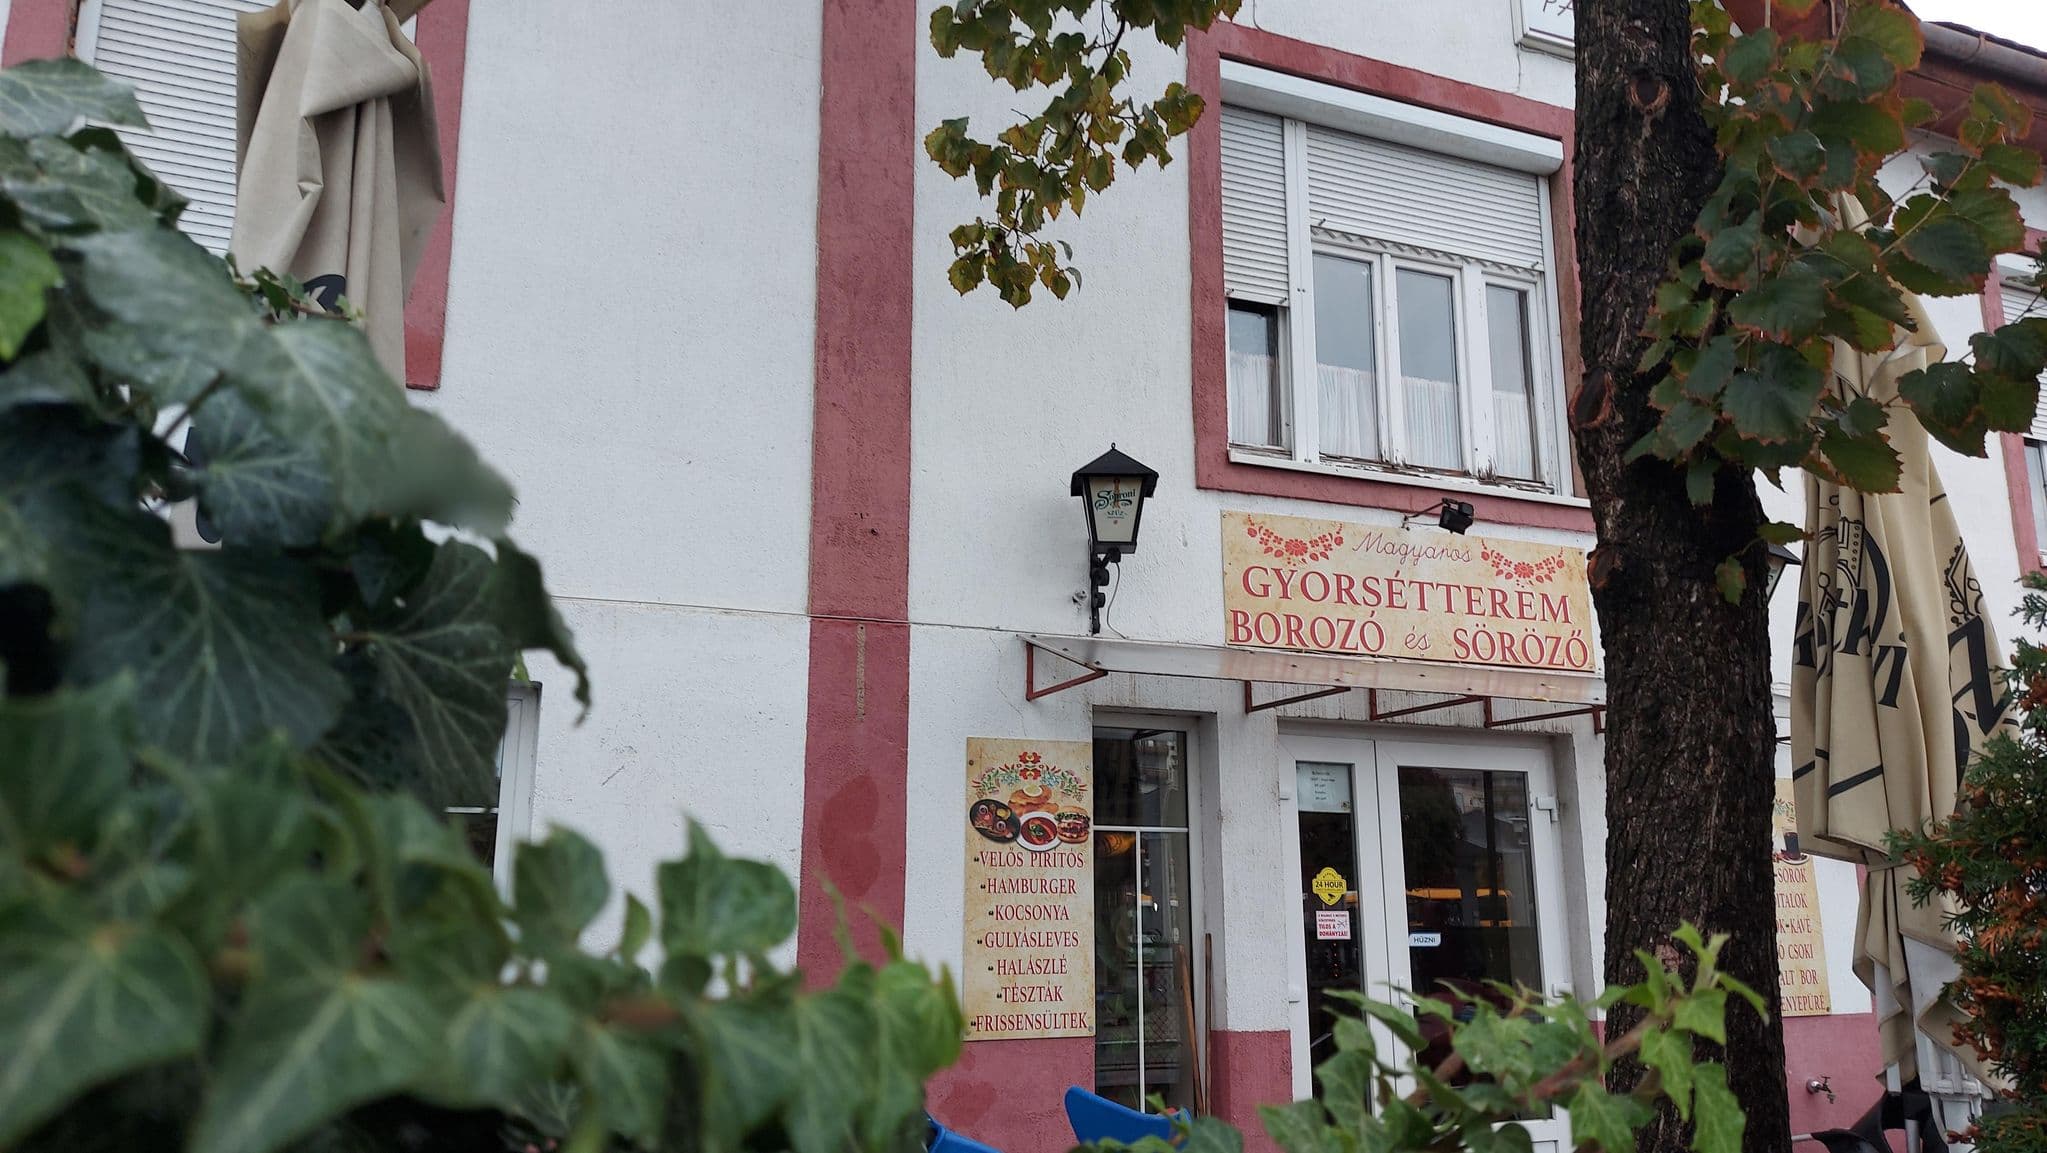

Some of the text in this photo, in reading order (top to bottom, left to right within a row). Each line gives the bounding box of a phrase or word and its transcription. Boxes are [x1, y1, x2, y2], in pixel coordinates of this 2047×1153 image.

[1095, 489, 1136, 512] Soproni
[1352, 531, 1473, 566] Magyaros
[1242, 565, 1573, 624] GYORSÉTTEREM
[1230, 609, 1589, 668] BOROZÓ és SÖRÖZŐ
[980, 847, 1084, 868] VELŐS PIRÍTÓS
[987, 878, 1077, 894] HAMBURGER
[1776, 892, 1808, 908] ITALOK
[995, 904, 1070, 921] KOCSONYA
[985, 926, 1079, 948] GULYÁSLEVES
[1788, 944, 1814, 960] CSOKI
[997, 954, 1068, 975] HALÁSZLÉ
[1800, 968, 1818, 985] BOR
[1002, 980, 1063, 1002] TÉSZTÁK
[1781, 992, 1826, 1011] ENYEPÜRÉ
[976, 1009, 1088, 1032] FRISSENSÜLTEK
